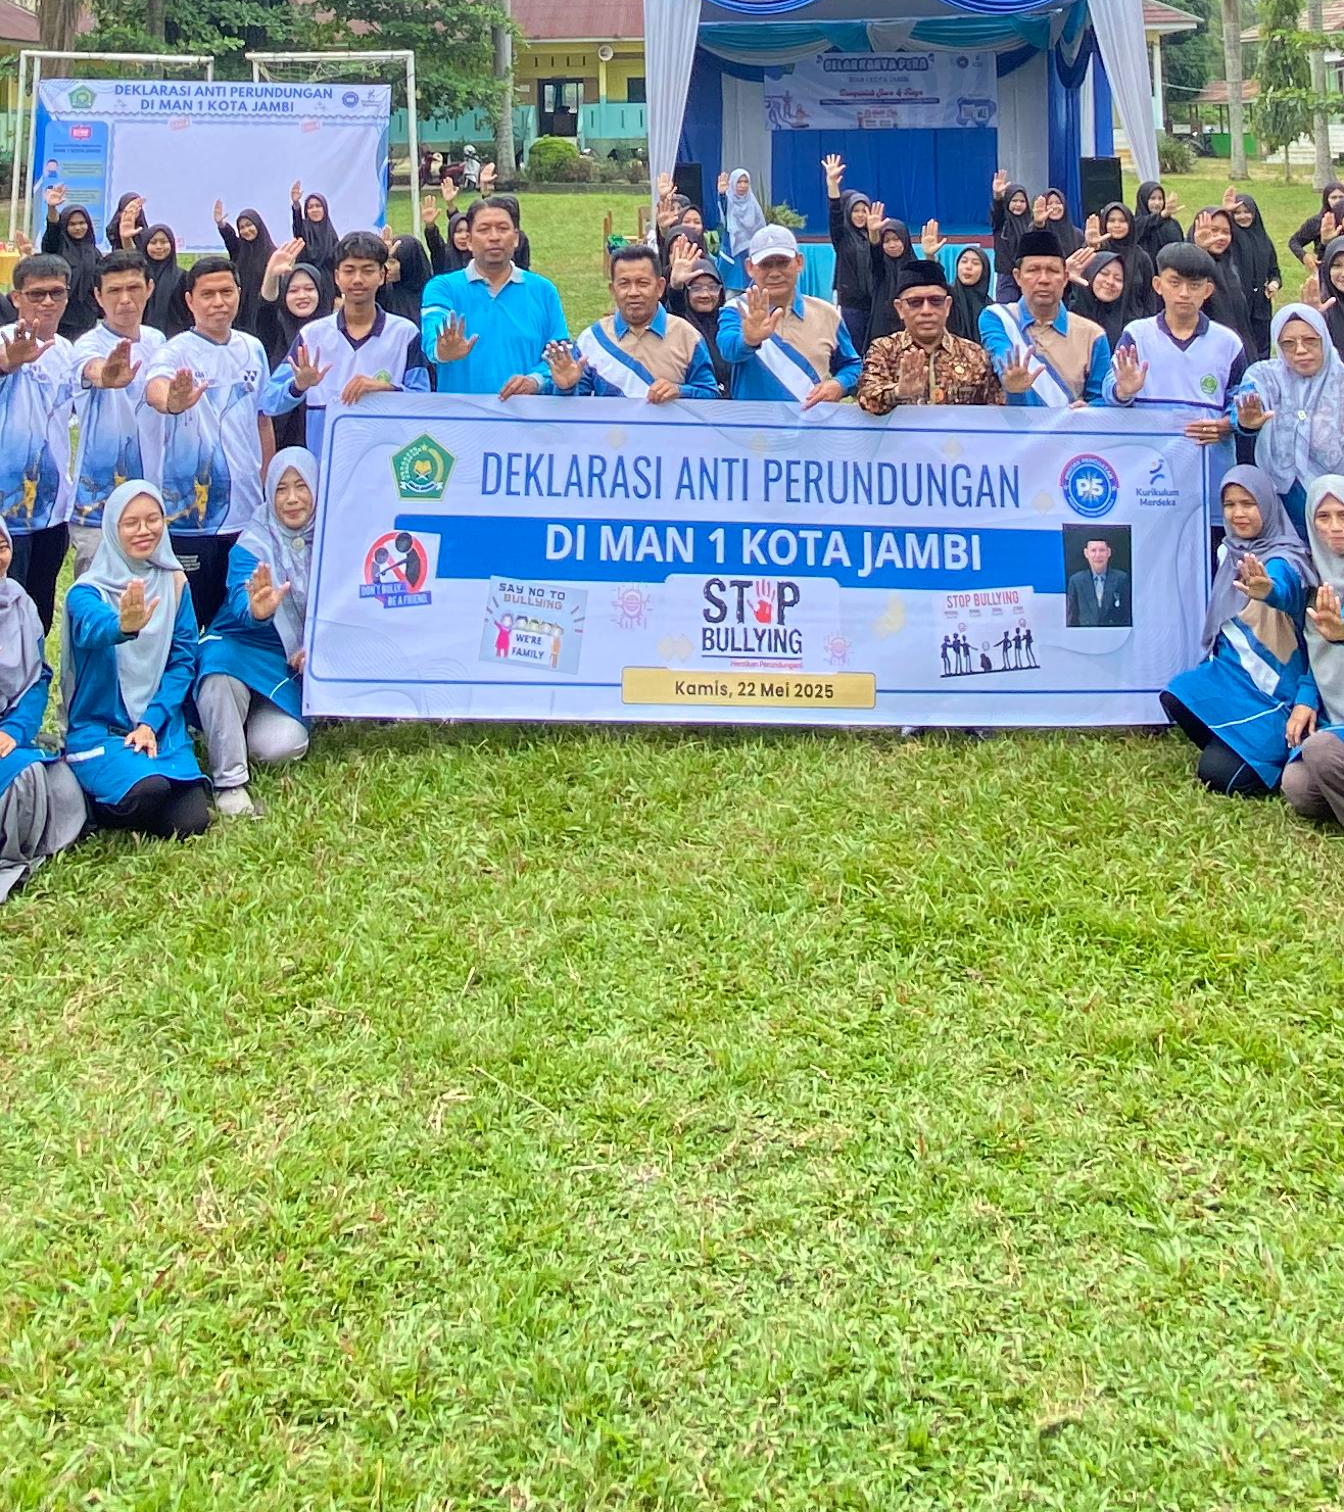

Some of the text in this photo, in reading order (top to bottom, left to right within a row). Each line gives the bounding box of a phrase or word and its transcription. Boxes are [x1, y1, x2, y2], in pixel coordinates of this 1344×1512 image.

[114, 84, 333, 99] DEKLARASI ANTI PERUNDUNGAN
[141, 99, 294, 112] DI MAN 1 KOTA JAMBI
[481, 451, 662, 499] DEKLARASI
[674, 456, 749, 502] ANTI
[763, 458, 1020, 509] PERUNDUNGAN
[1076, 478, 1105, 497] P5
[1136, 488, 1180, 497] Kurikulum
[1140, 498, 1176, 507] Merdeka
[545, 523, 982, 578] DI MAN 1 KOTA JAMBI
[499, 583, 566, 600] SAY NO TO
[947, 590, 1019, 608] STOP BULLYING
[503, 593, 563, 610] BULLYING
[702, 627, 803, 654] BULLYING
[512, 647, 544, 659] FAMILY
[674, 680, 834, 698] Kamis, 22 Mei 2025
